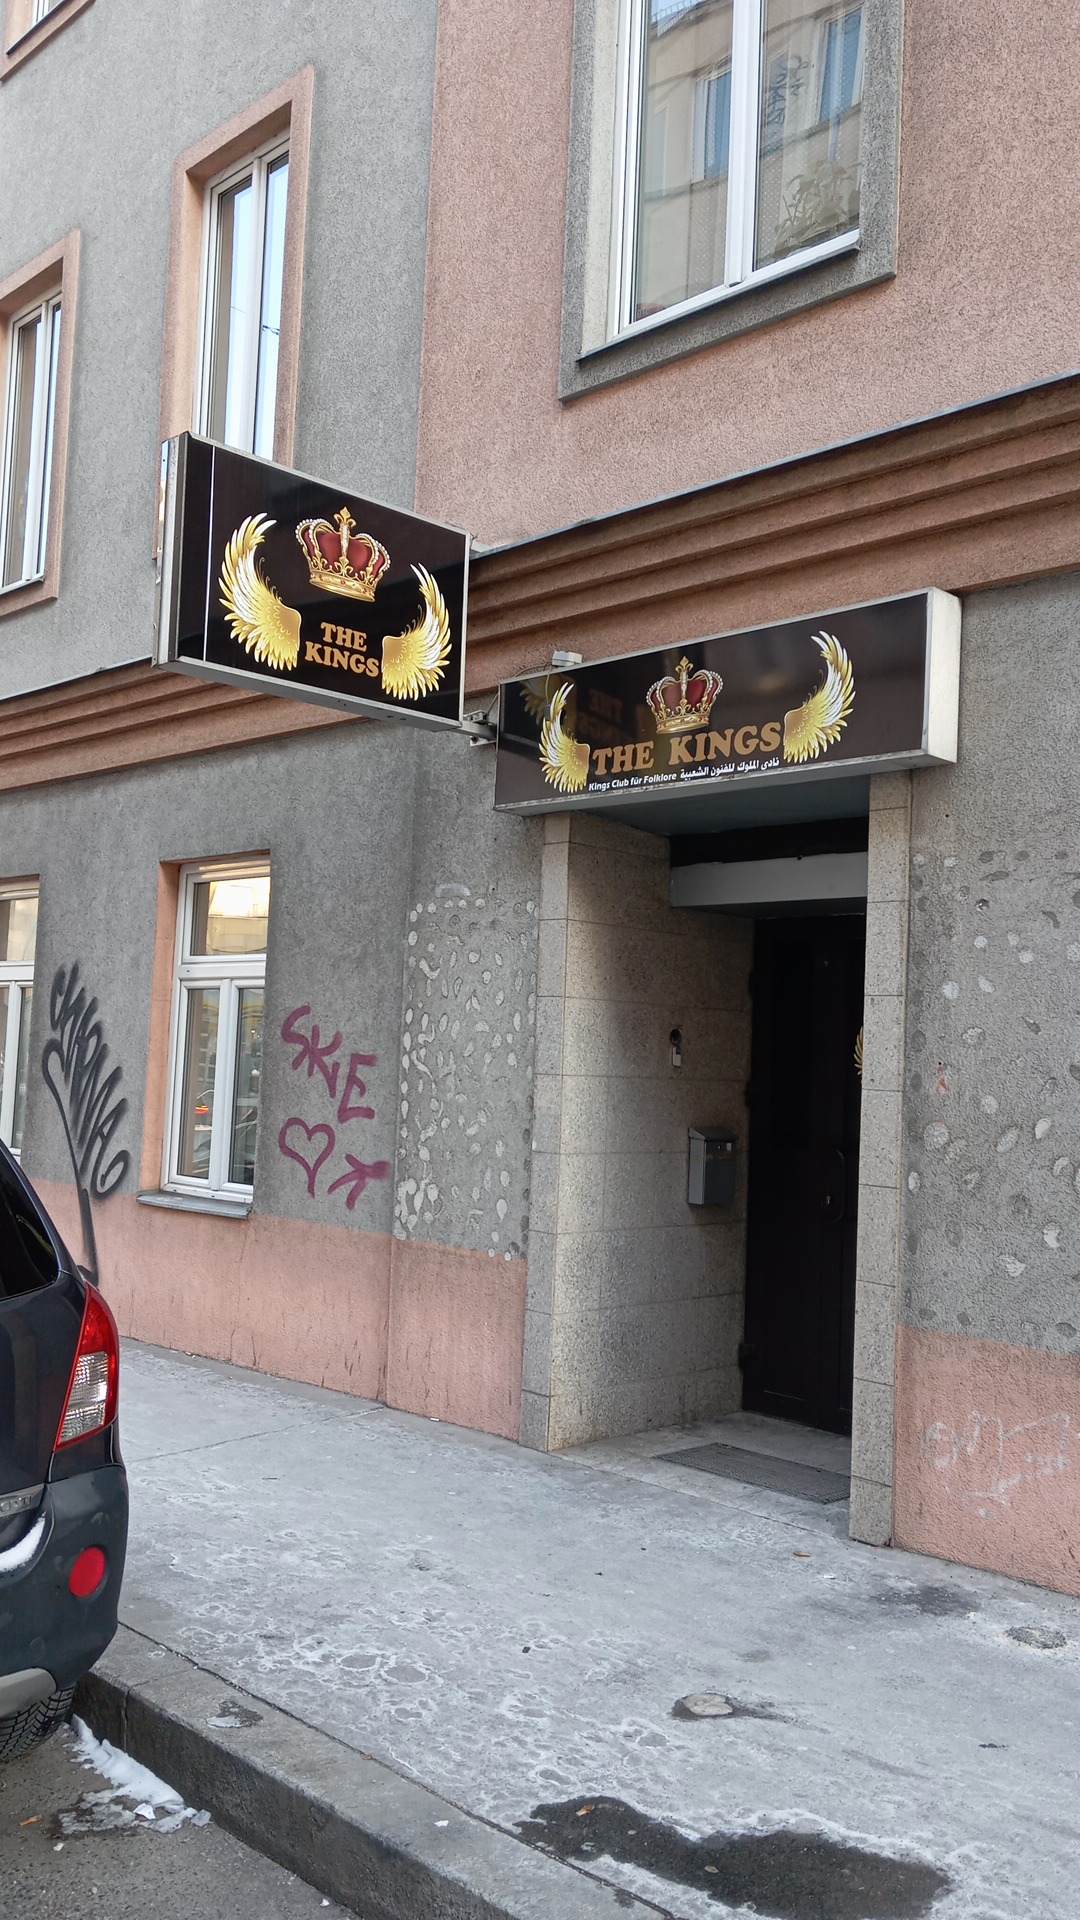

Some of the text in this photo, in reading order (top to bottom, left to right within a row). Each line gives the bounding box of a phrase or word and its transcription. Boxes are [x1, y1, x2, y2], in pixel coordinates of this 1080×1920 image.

[320, 621, 367, 652] THE
[304, 641, 380, 678] KINGS
[592, 740, 655, 776] THE
[668, 722, 782, 766] KINGS
[588, 772, 678, 792] Kings Club für Folklore
[680, 765, 709, 781] الشعبية
